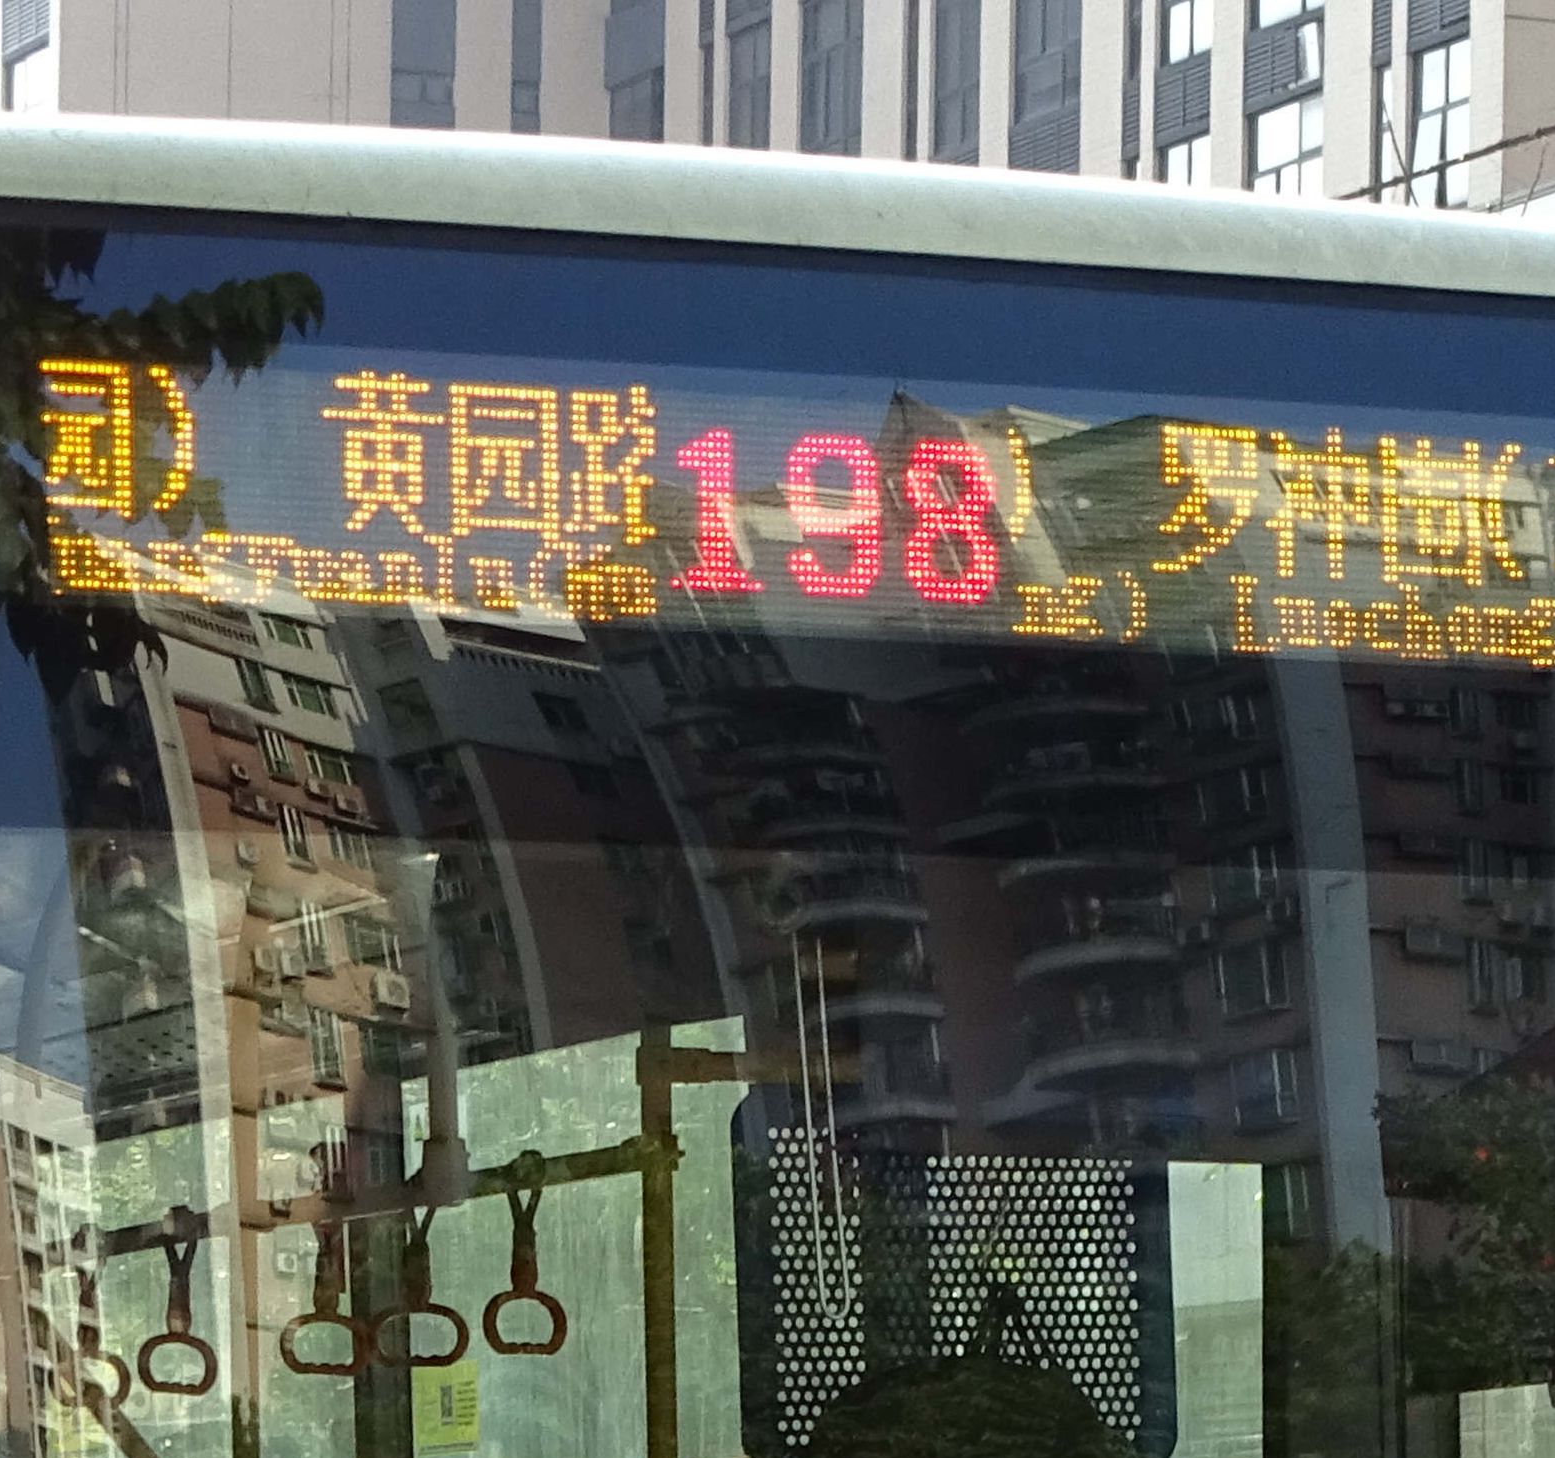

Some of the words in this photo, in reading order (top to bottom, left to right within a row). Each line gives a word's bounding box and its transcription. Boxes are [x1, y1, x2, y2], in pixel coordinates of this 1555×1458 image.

[320, 369, 657, 547] 黄园路
[669, 427, 1000, 606] 198
